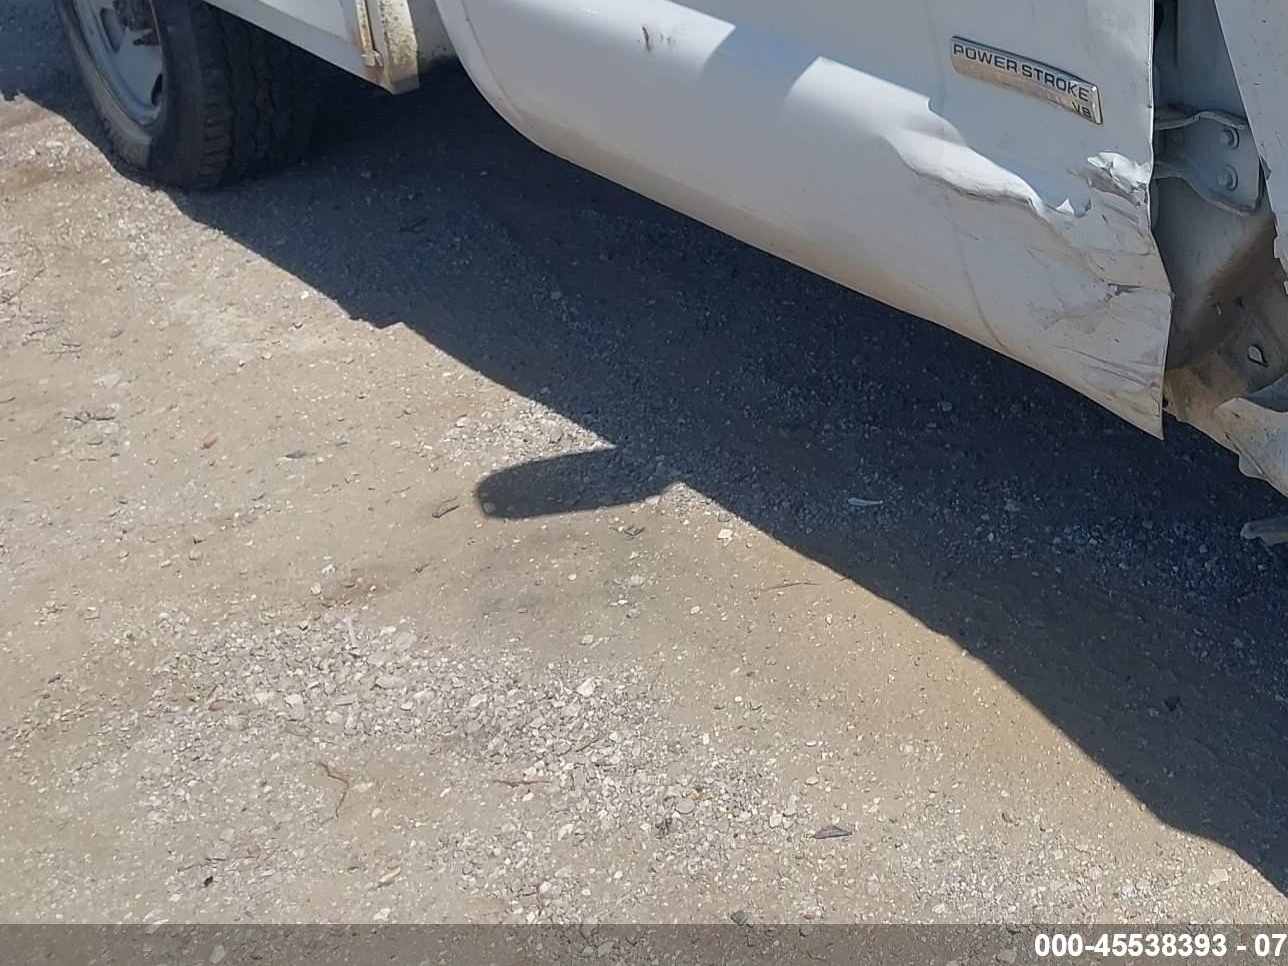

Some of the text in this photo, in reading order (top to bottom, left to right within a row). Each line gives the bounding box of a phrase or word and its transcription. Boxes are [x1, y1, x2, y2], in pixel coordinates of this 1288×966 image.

[953, 43, 1090, 102] POWER STROKE
[1072, 101, 1092, 119] V8
